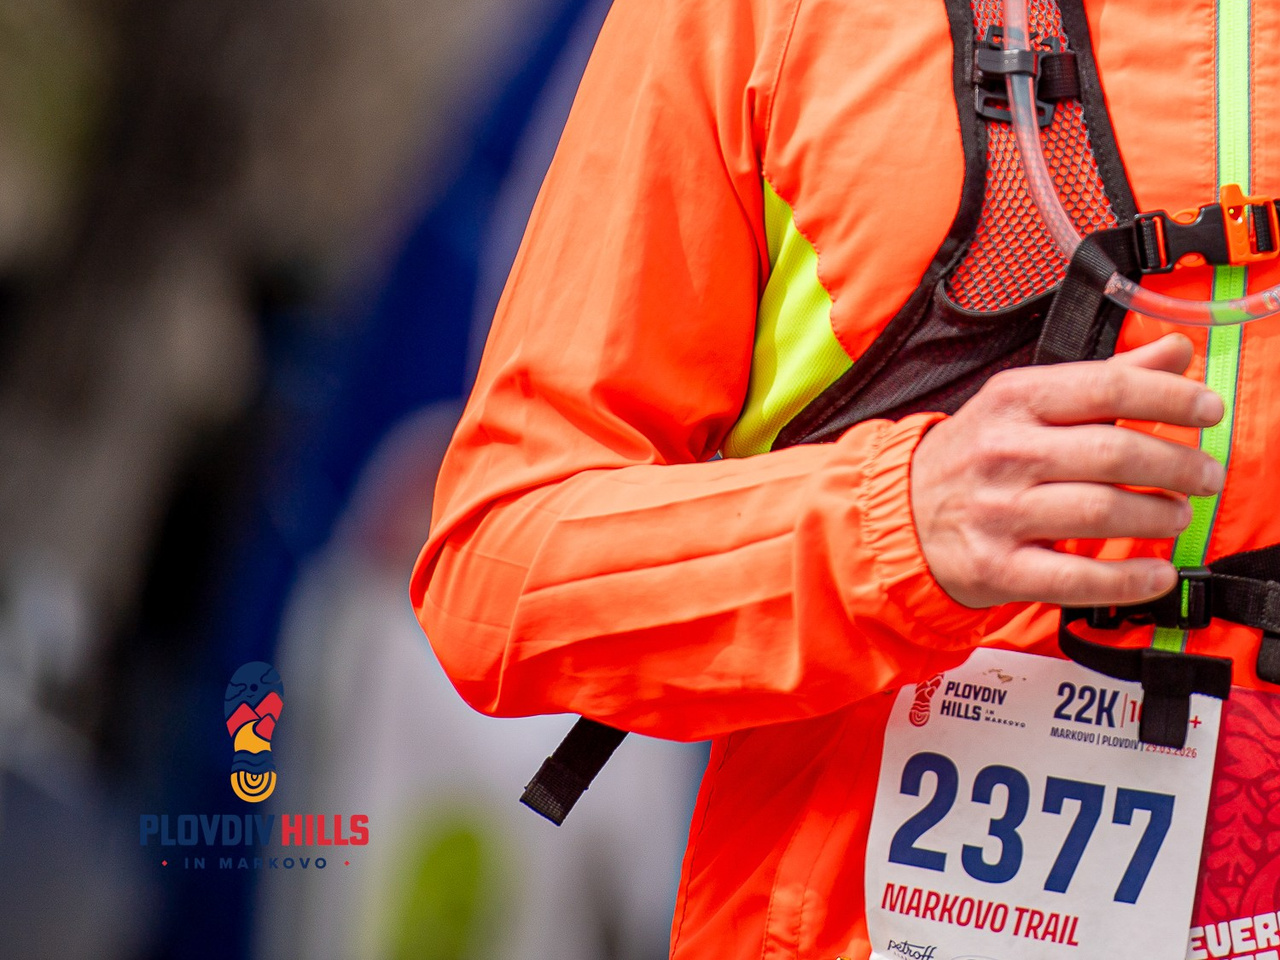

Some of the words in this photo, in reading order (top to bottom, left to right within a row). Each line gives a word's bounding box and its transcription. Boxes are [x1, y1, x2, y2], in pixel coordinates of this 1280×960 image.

[940, 700, 982, 721] HILLS
[944, 681, 1008, 706] PLOVDIV
[1053, 681, 1120, 728] 22K
[1050, 726, 1095, 745] MARKOVO
[1101, 735, 1140, 750] PLOVDIV
[888, 751, 1176, 905] 2377
[881, 883, 1009, 933] MARKOVO
[1014, 907, 1080, 947] TRAIL
